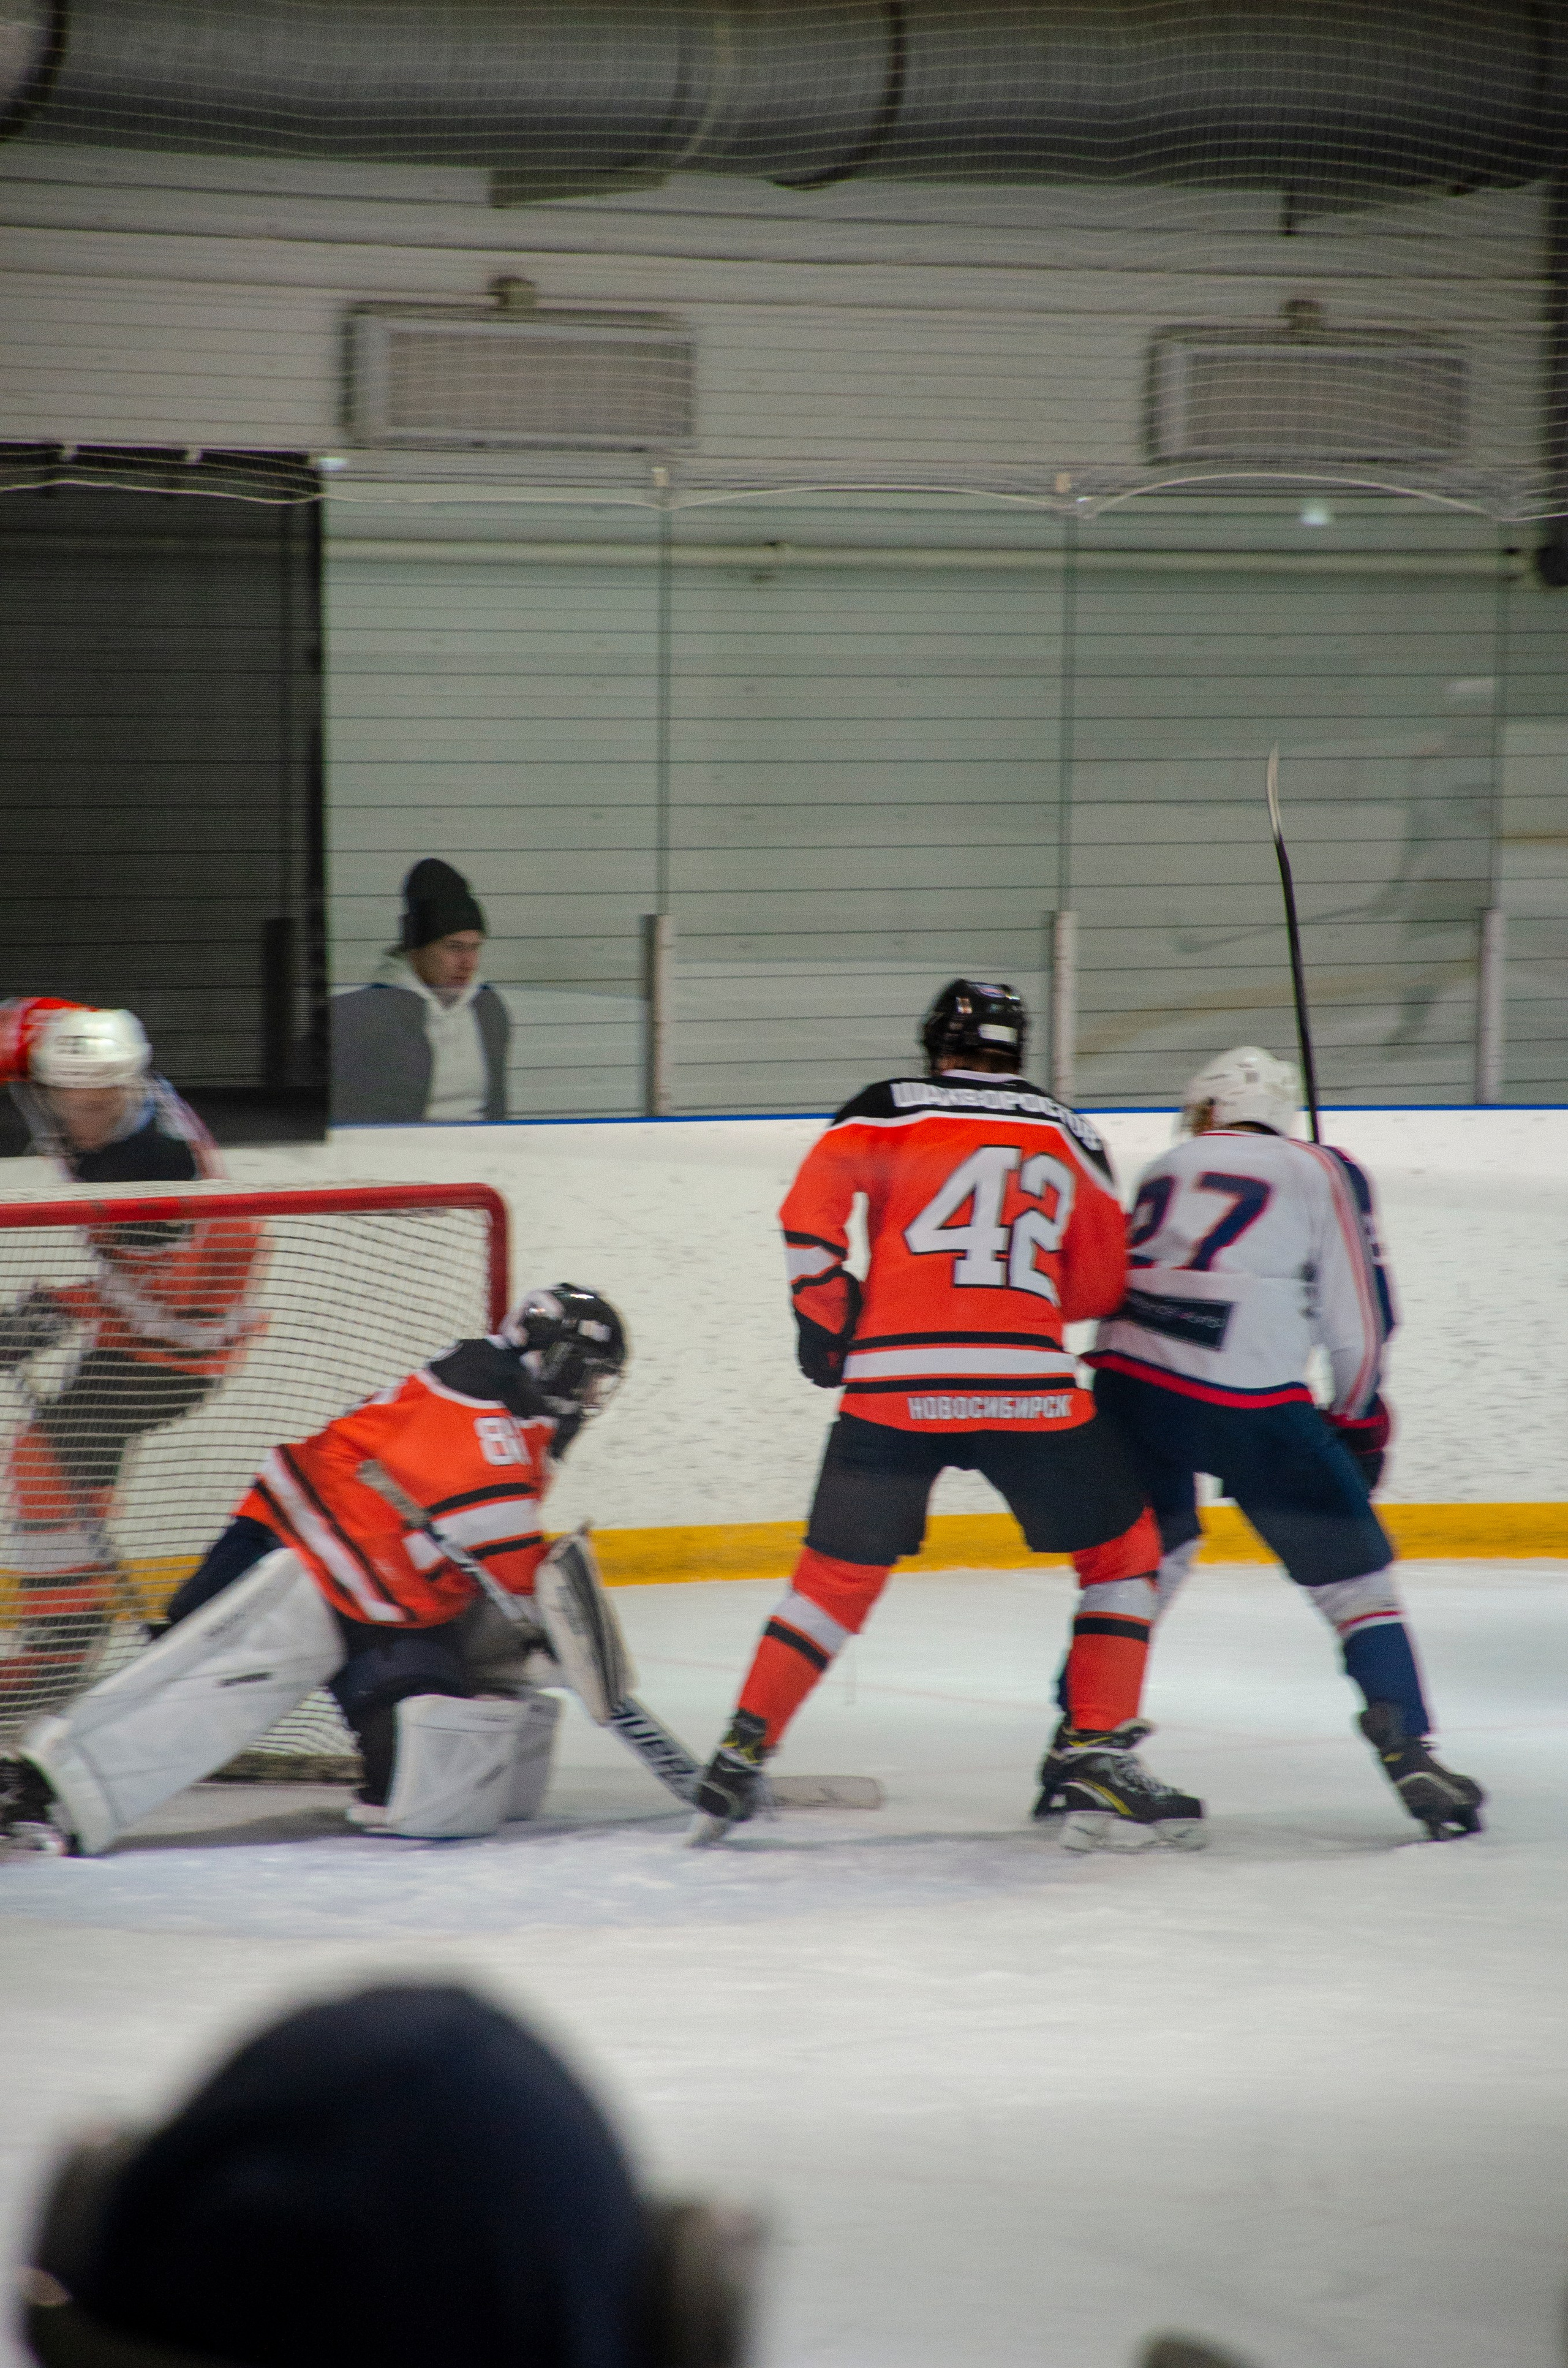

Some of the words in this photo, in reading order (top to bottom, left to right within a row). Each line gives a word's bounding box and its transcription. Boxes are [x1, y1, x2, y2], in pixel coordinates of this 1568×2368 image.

[903, 1144, 1076, 1307] 42
[1127, 1170, 1272, 1273] 27
[907, 1394, 1073, 1420] НОВОСИБИРСК
